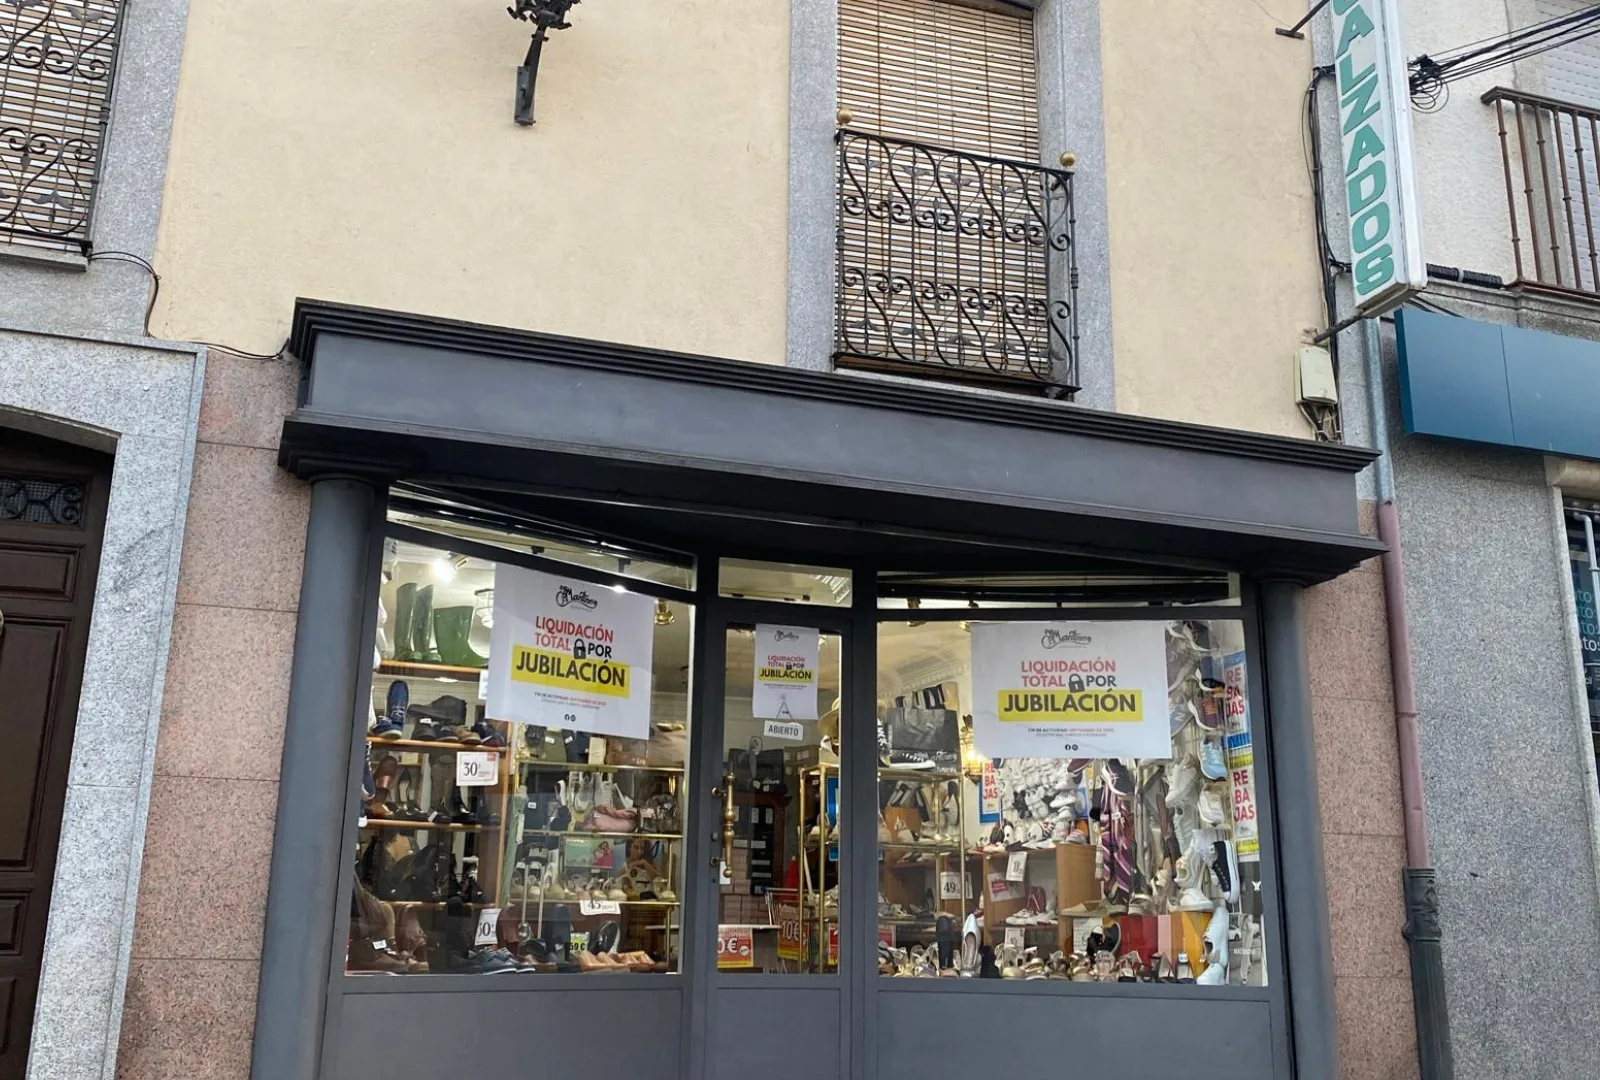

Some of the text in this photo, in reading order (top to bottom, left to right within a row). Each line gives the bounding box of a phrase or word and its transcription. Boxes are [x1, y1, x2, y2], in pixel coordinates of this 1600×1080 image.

[535, 615, 614, 643] LIQUIDACIÓN
[534, 632, 612, 659] TOTAL POR
[767, 654, 806, 663] LIQUIDACIÓN
[1021, 656, 1116, 675] LIQUIDACIÓN
[516, 650, 626, 687] JUBILACIÓN
[760, 668, 812, 680] JUBILACIÓN
[1227, 667, 1243, 683] RE
[1021, 675, 1117, 687] TOTAL POR
[1003, 688, 1136, 713] JUBILACIÓN
[768, 724, 799, 737] ABIERTO
[984, 762, 995, 773] RE
[984, 776, 996, 786] BA
[1233, 769, 1249, 787] RE
[983, 788, 998, 800] JAS
[1234, 787, 1250, 805] BA
[1233, 804, 1255, 822] JAS
